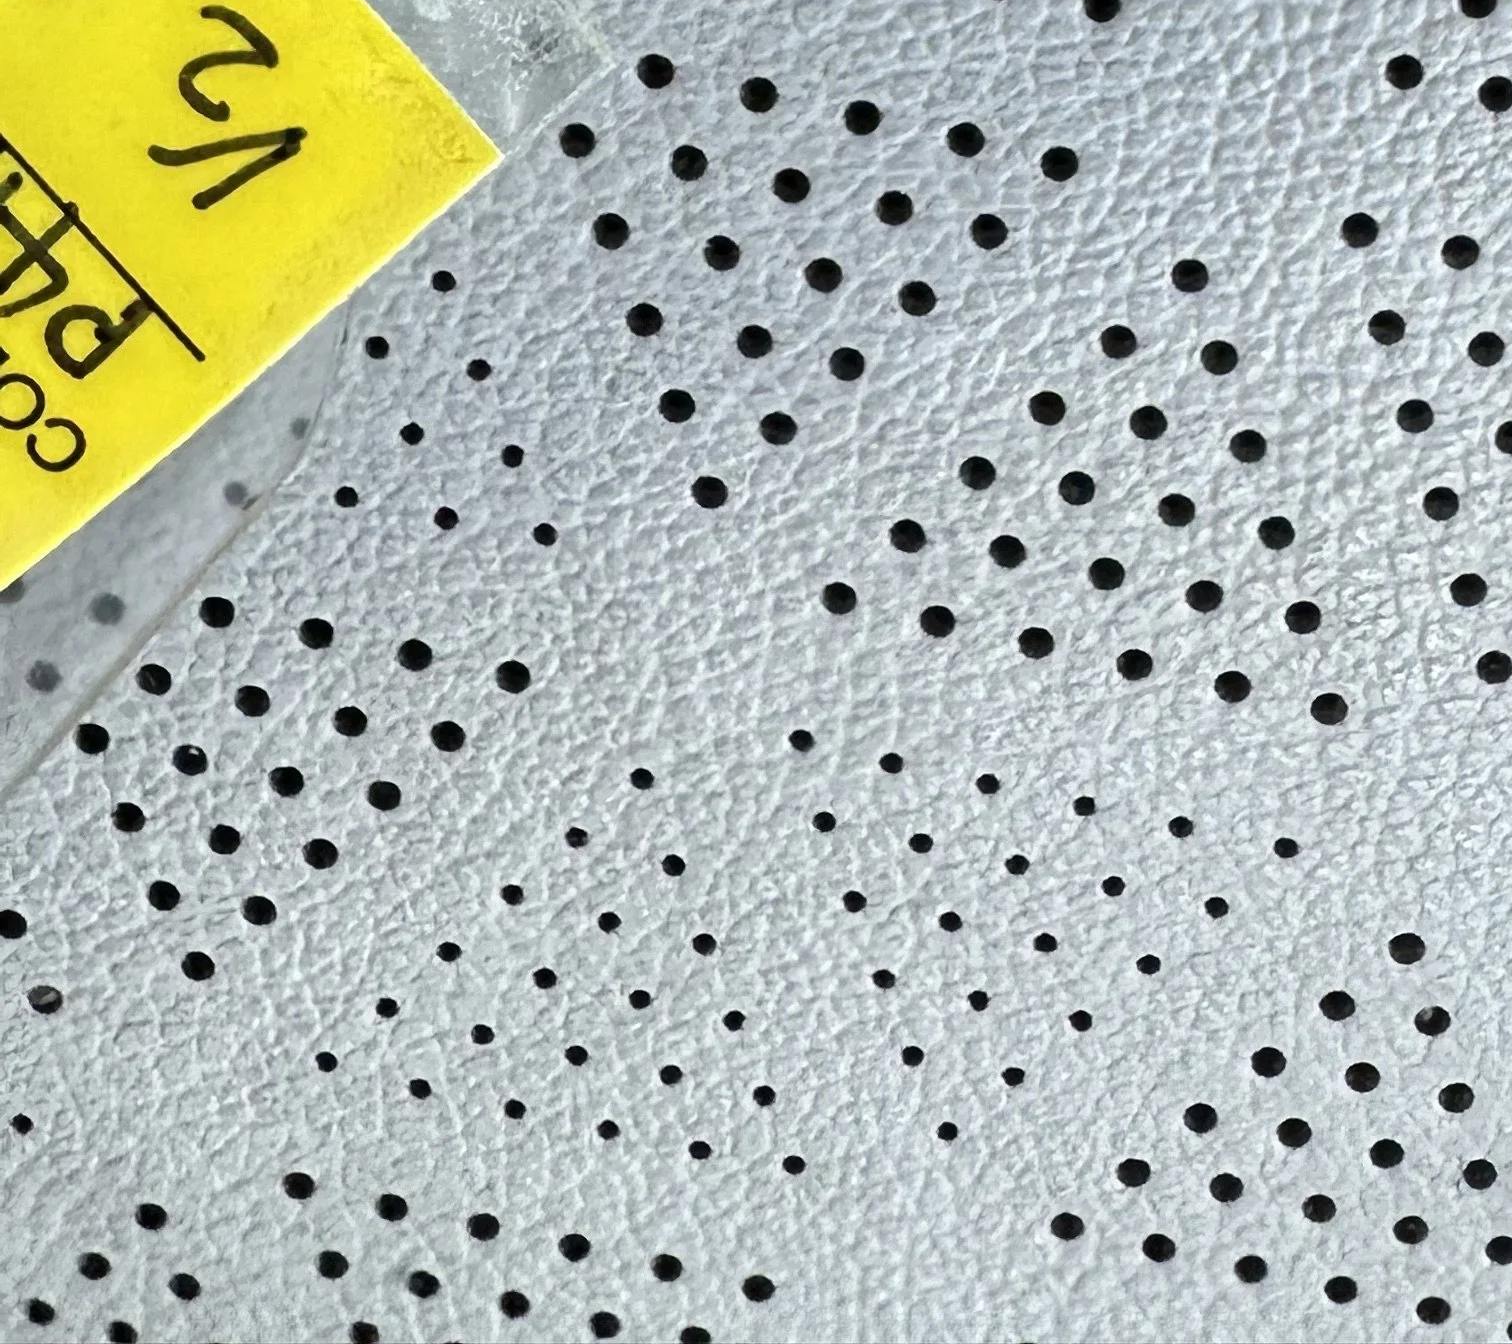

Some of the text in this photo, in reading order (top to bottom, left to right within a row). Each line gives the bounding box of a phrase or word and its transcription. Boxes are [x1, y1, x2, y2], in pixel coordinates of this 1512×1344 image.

[148, 4, 307, 210] V2
[0, 169, 157, 380] P4
[0, 345, 86, 473] CO
